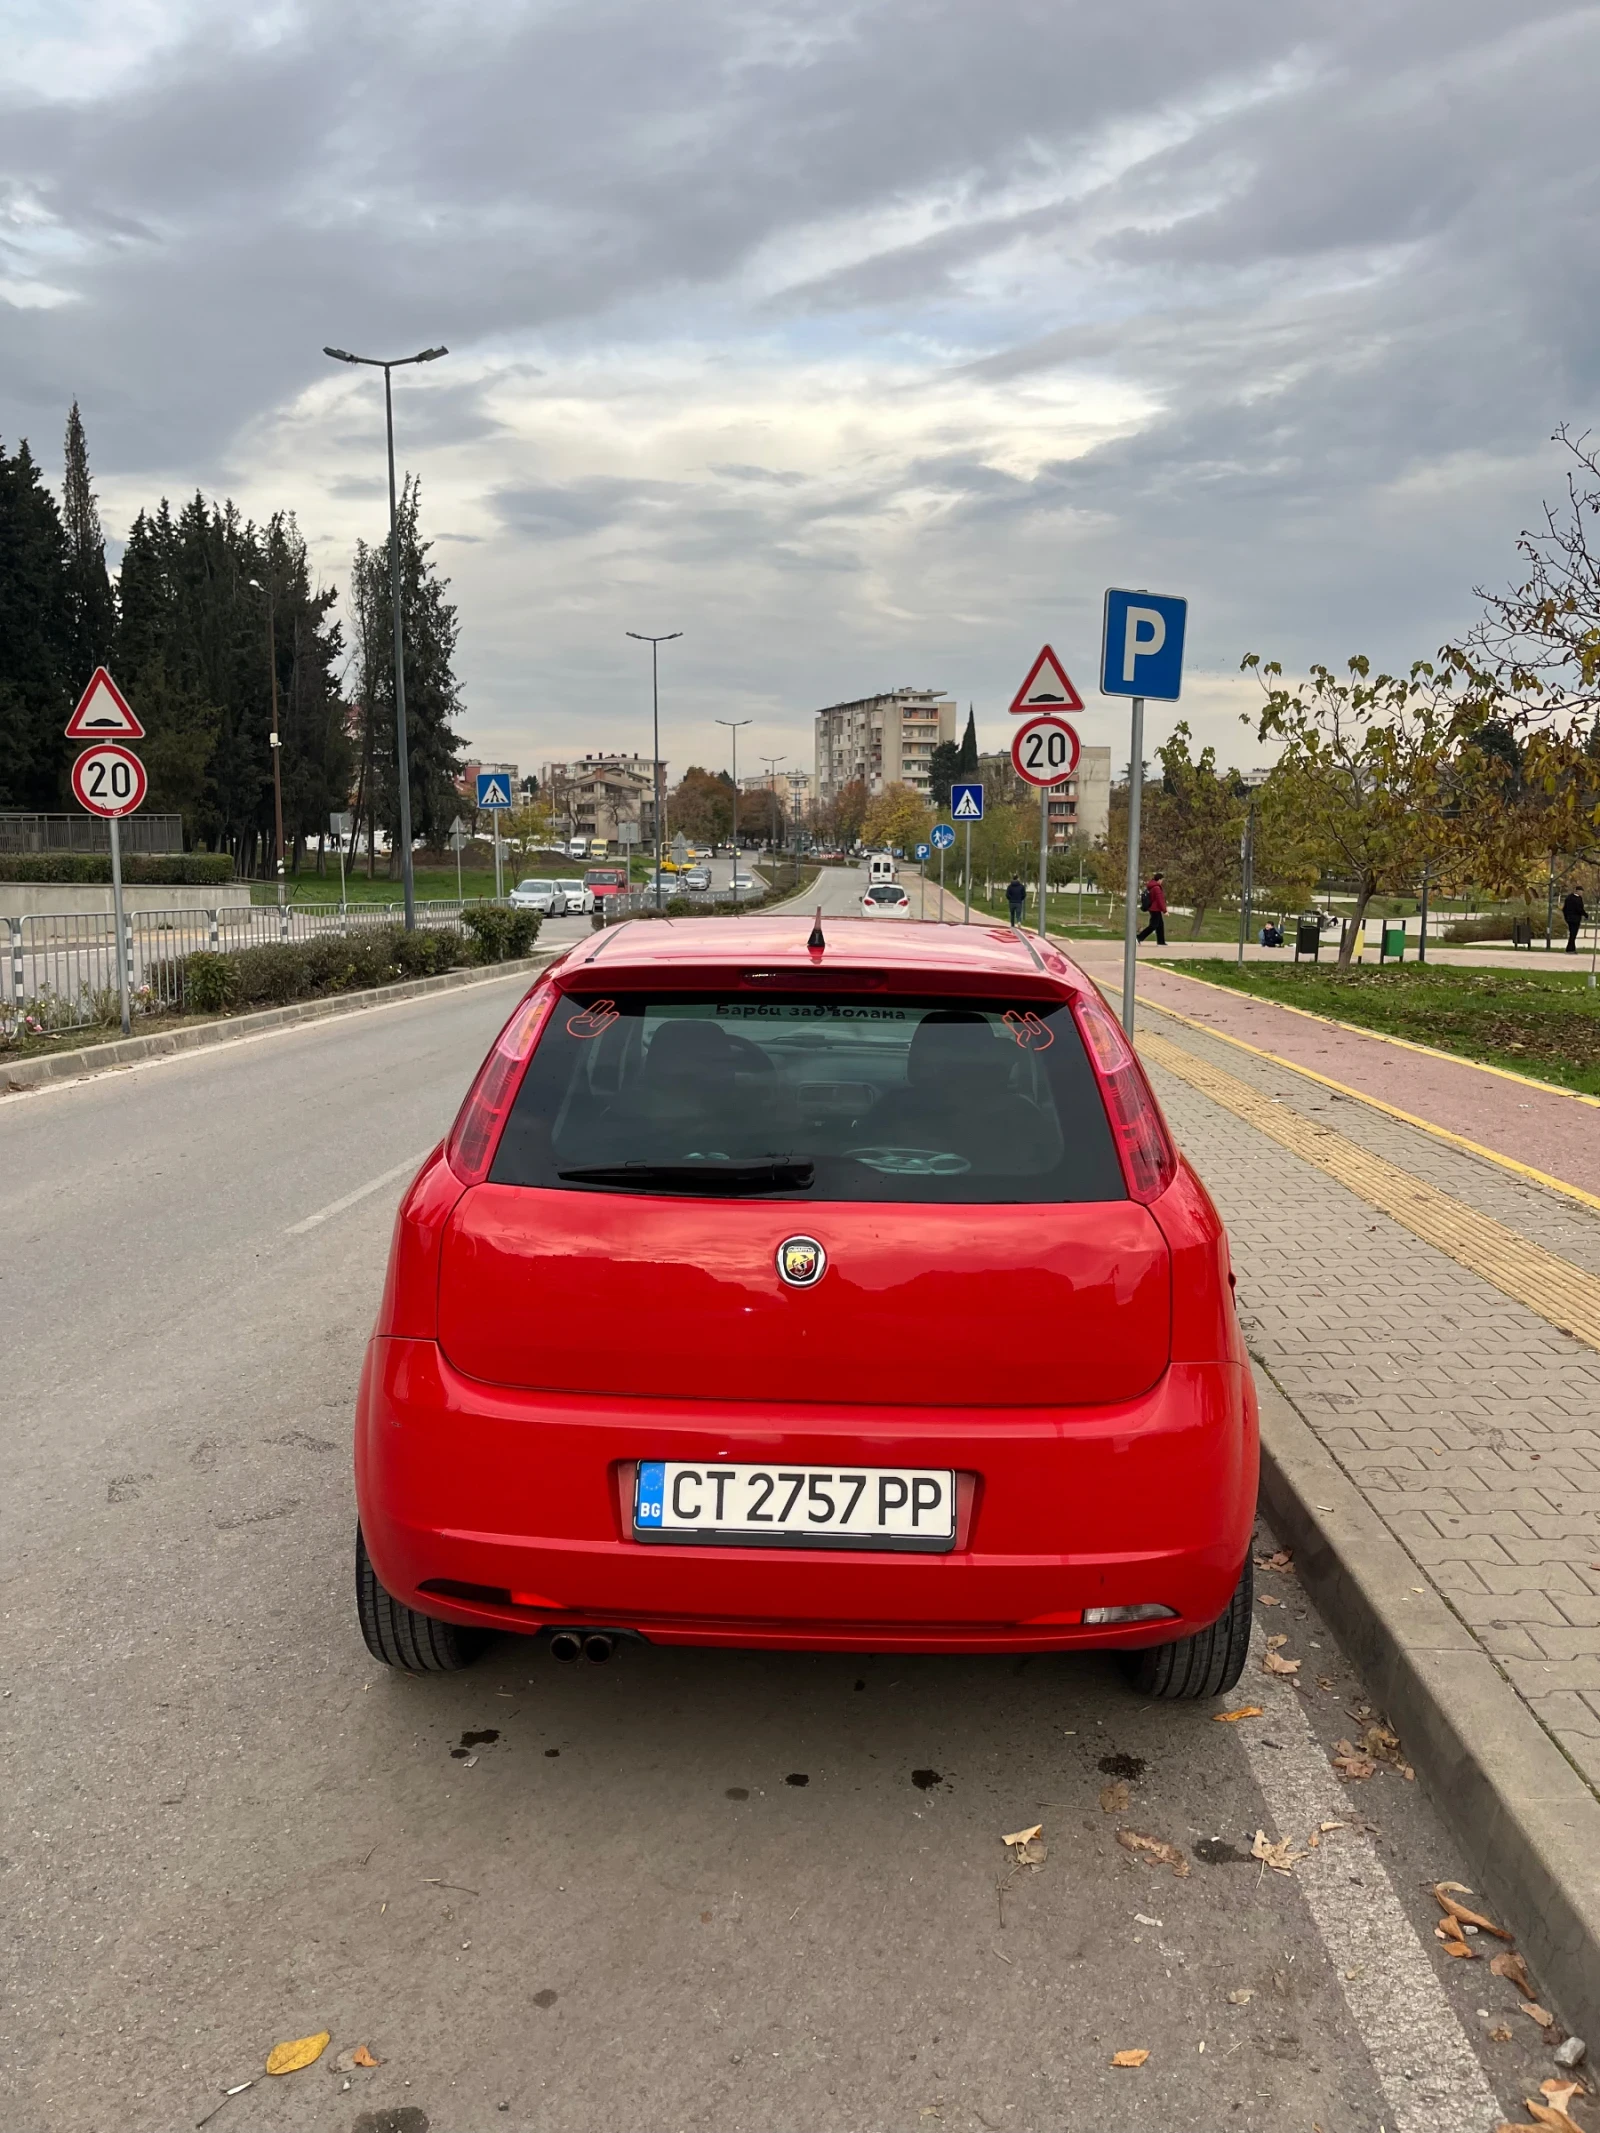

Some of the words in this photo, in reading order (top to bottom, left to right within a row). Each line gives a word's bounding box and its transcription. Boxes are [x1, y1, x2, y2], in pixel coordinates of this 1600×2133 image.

[1122, 605, 1166, 682] P
[1026, 732, 1066, 769] 20
[87, 761, 131, 798] 20
[917, 845, 927, 858] P
[716, 1003, 781, 1018] Барби
[788, 1004, 827, 1017] зад
[640, 1502, 661, 1518] BG
[746, 1472, 867, 1524] 2757
